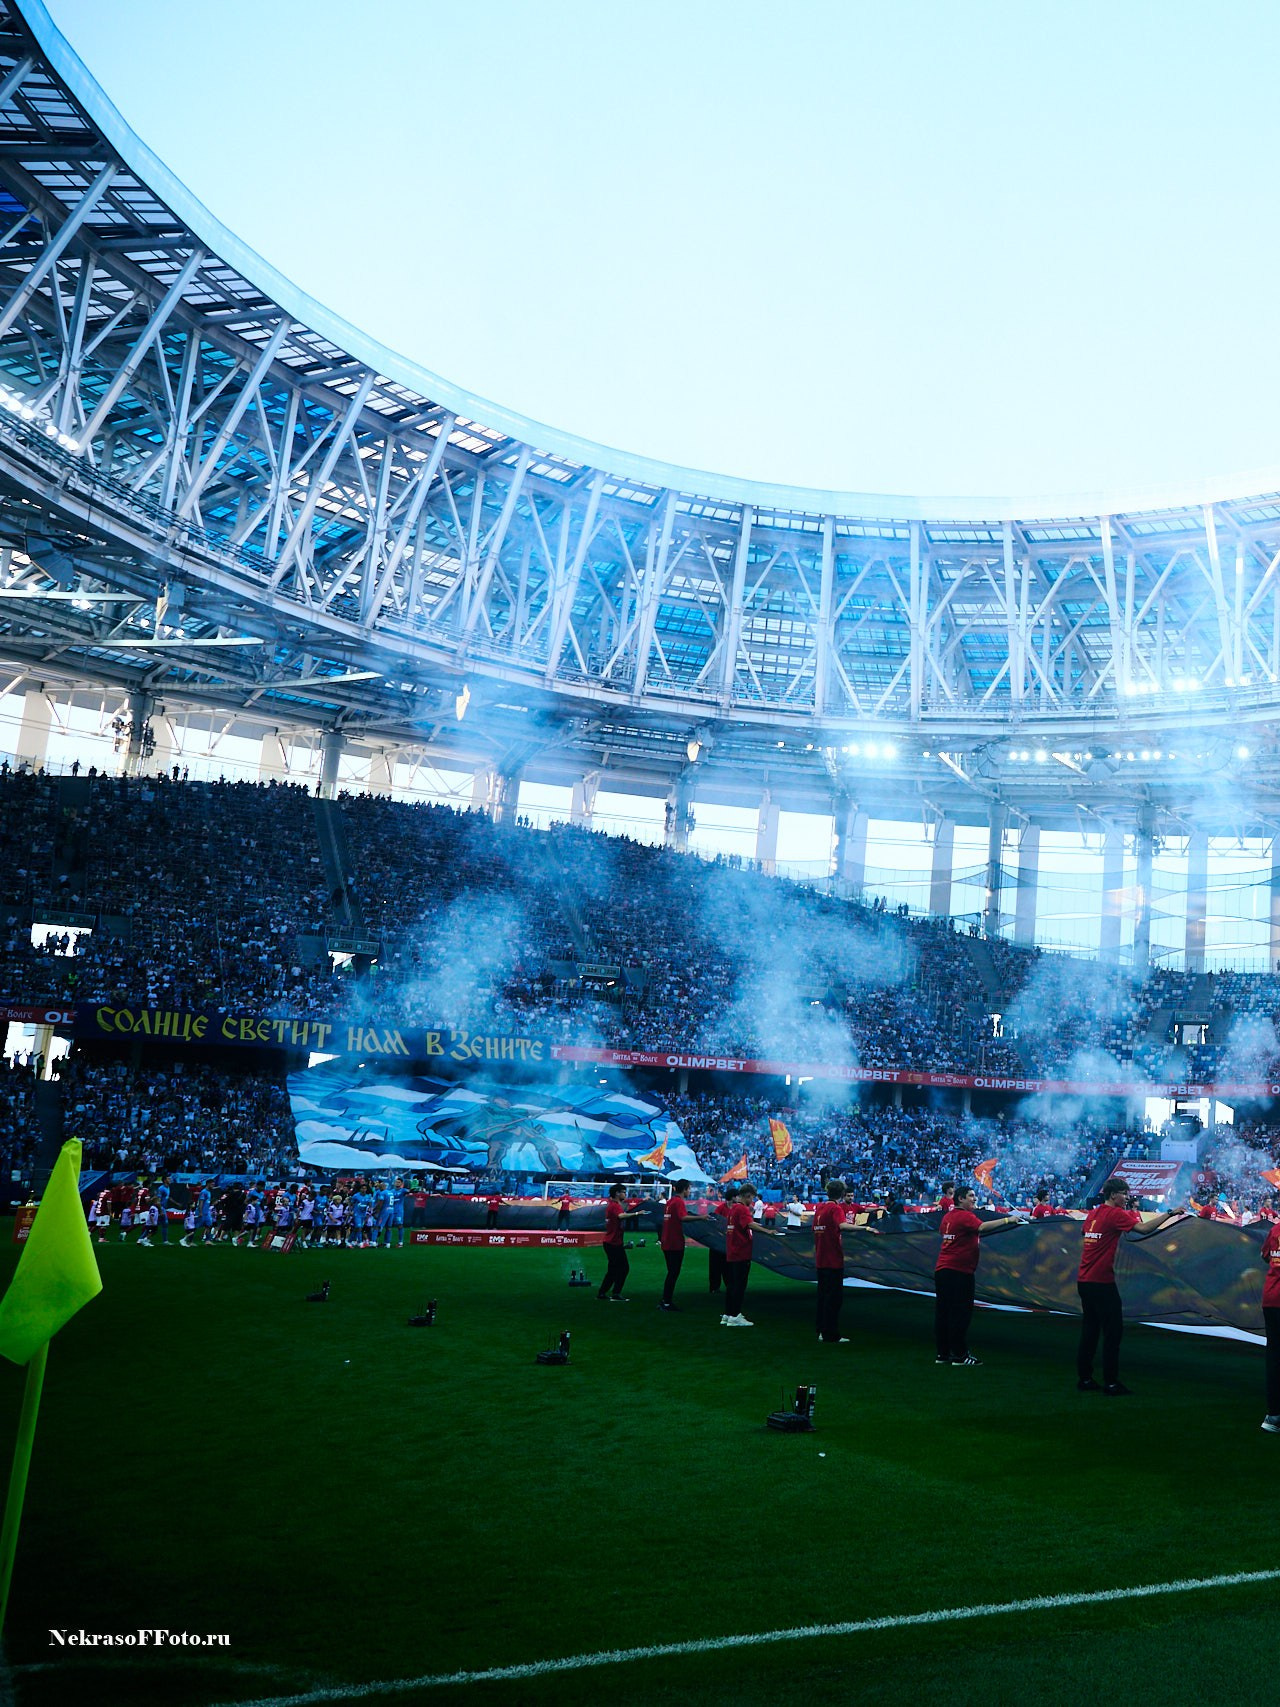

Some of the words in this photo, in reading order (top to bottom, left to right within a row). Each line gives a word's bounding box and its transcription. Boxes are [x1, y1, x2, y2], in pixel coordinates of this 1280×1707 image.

[666, 1056, 747, 1070] OLIMPBET
[974, 1078, 1042, 1090] OLIMPBET
[1134, 1085, 1204, 1095] OLIMPBET
